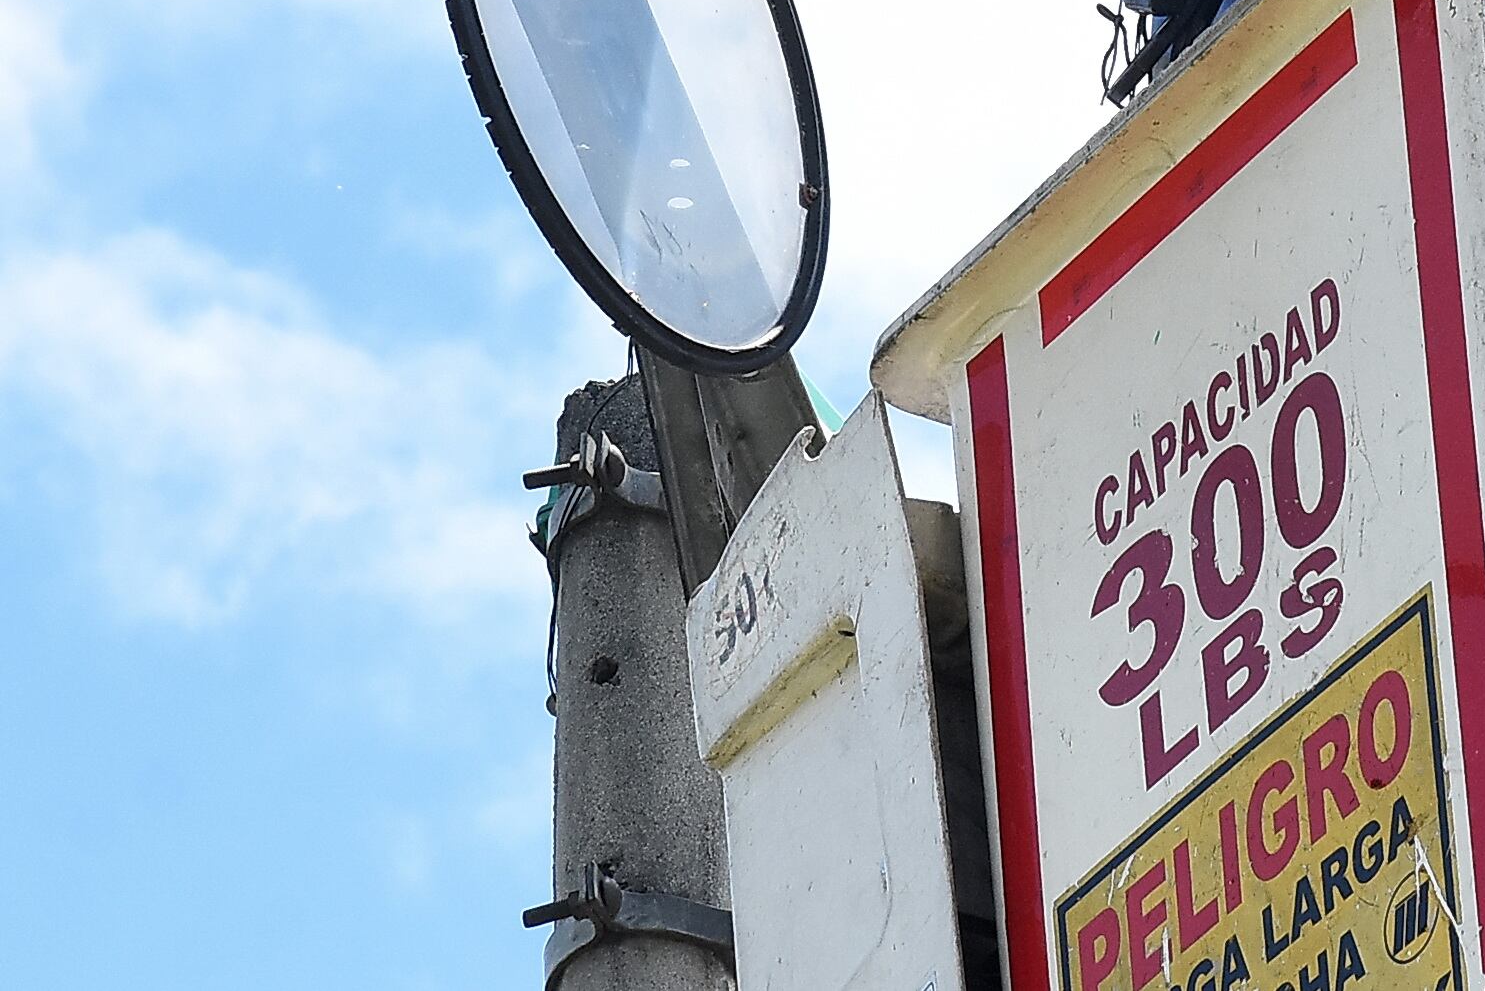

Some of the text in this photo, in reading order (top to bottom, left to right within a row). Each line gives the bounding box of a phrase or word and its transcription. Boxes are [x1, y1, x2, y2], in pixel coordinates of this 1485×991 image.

[1091, 370, 1347, 709] 300
[1094, 278, 1341, 547] CAPACIDAD
[1139, 546, 1344, 792] LBS
[1076, 670, 1415, 991] PELIGRO
[1262, 794, 1418, 964] LARGA
